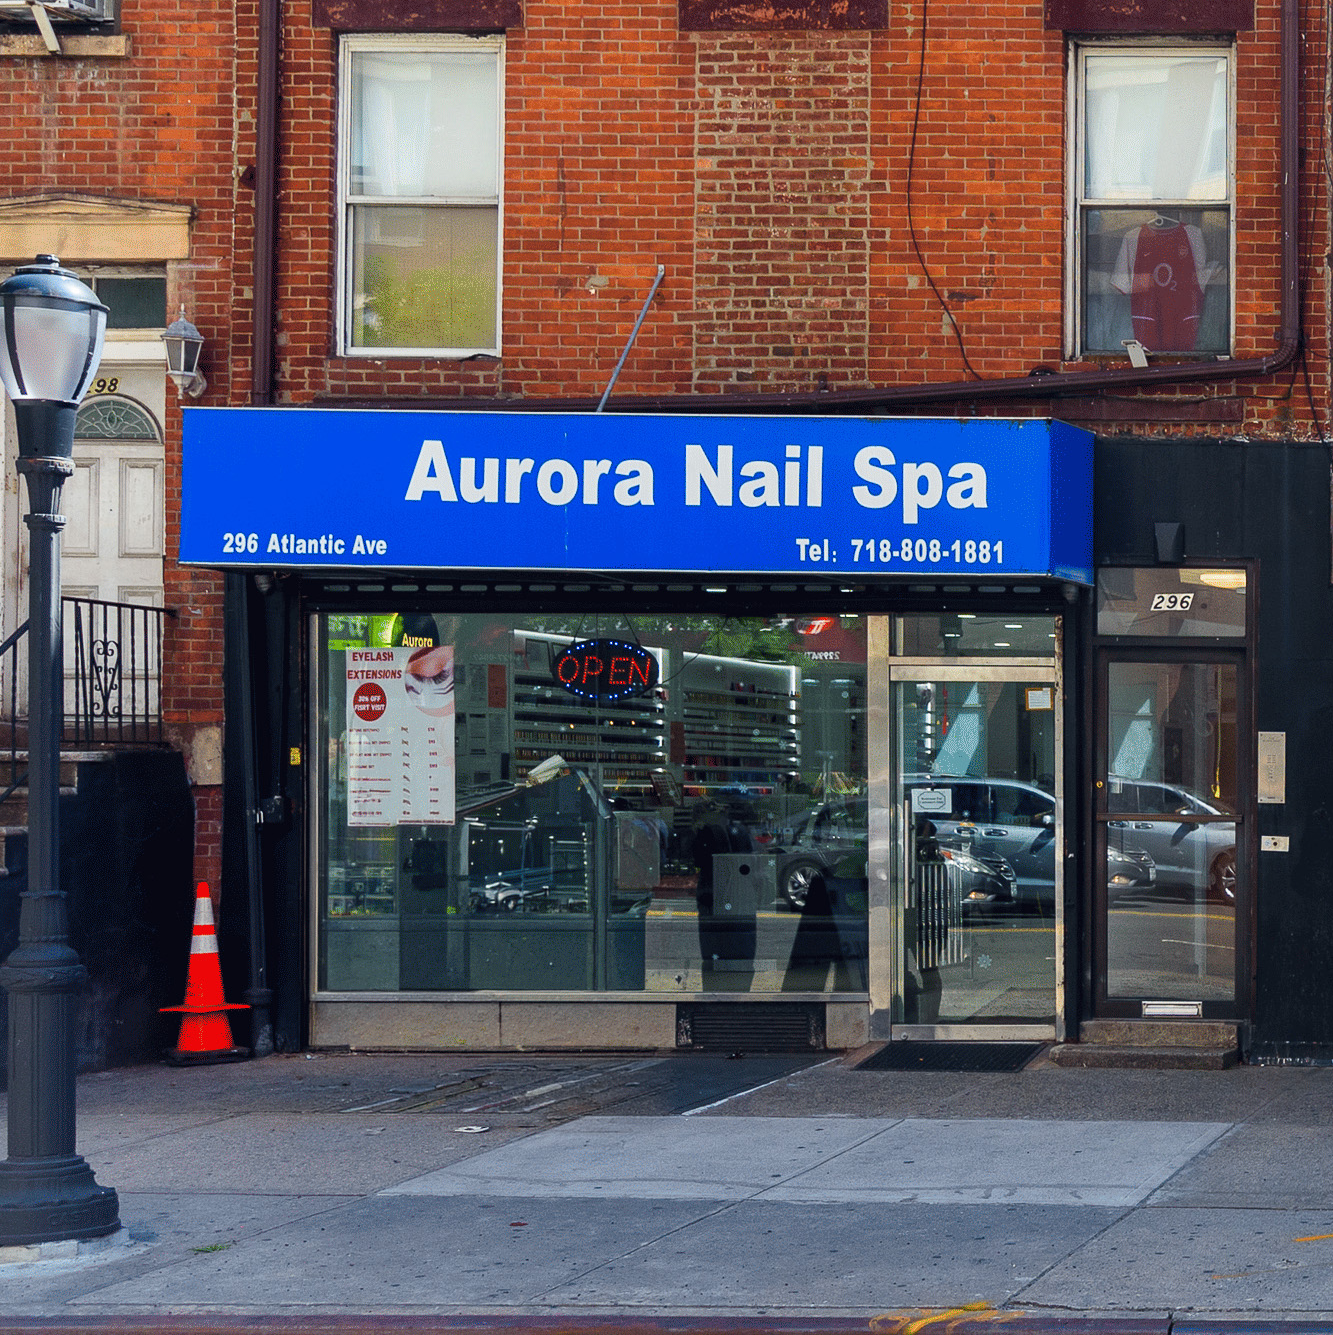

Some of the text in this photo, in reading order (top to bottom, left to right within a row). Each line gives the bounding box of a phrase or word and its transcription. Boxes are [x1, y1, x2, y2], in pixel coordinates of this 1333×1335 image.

[87, 377, 119, 393] 98
[404, 439, 988, 524] Aurora Nail Spa
[223, 532, 387, 555] 296 Atlantic Ave
[796, 538, 1004, 564] Tel: 718-808-1881
[1153, 595, 1191, 609] 296
[402, 633, 433, 647] Aurora
[352, 651, 394, 662] EYELASH
[347, 669, 402, 680] EXTENSIONS
[557, 655, 651, 686] OPEN
